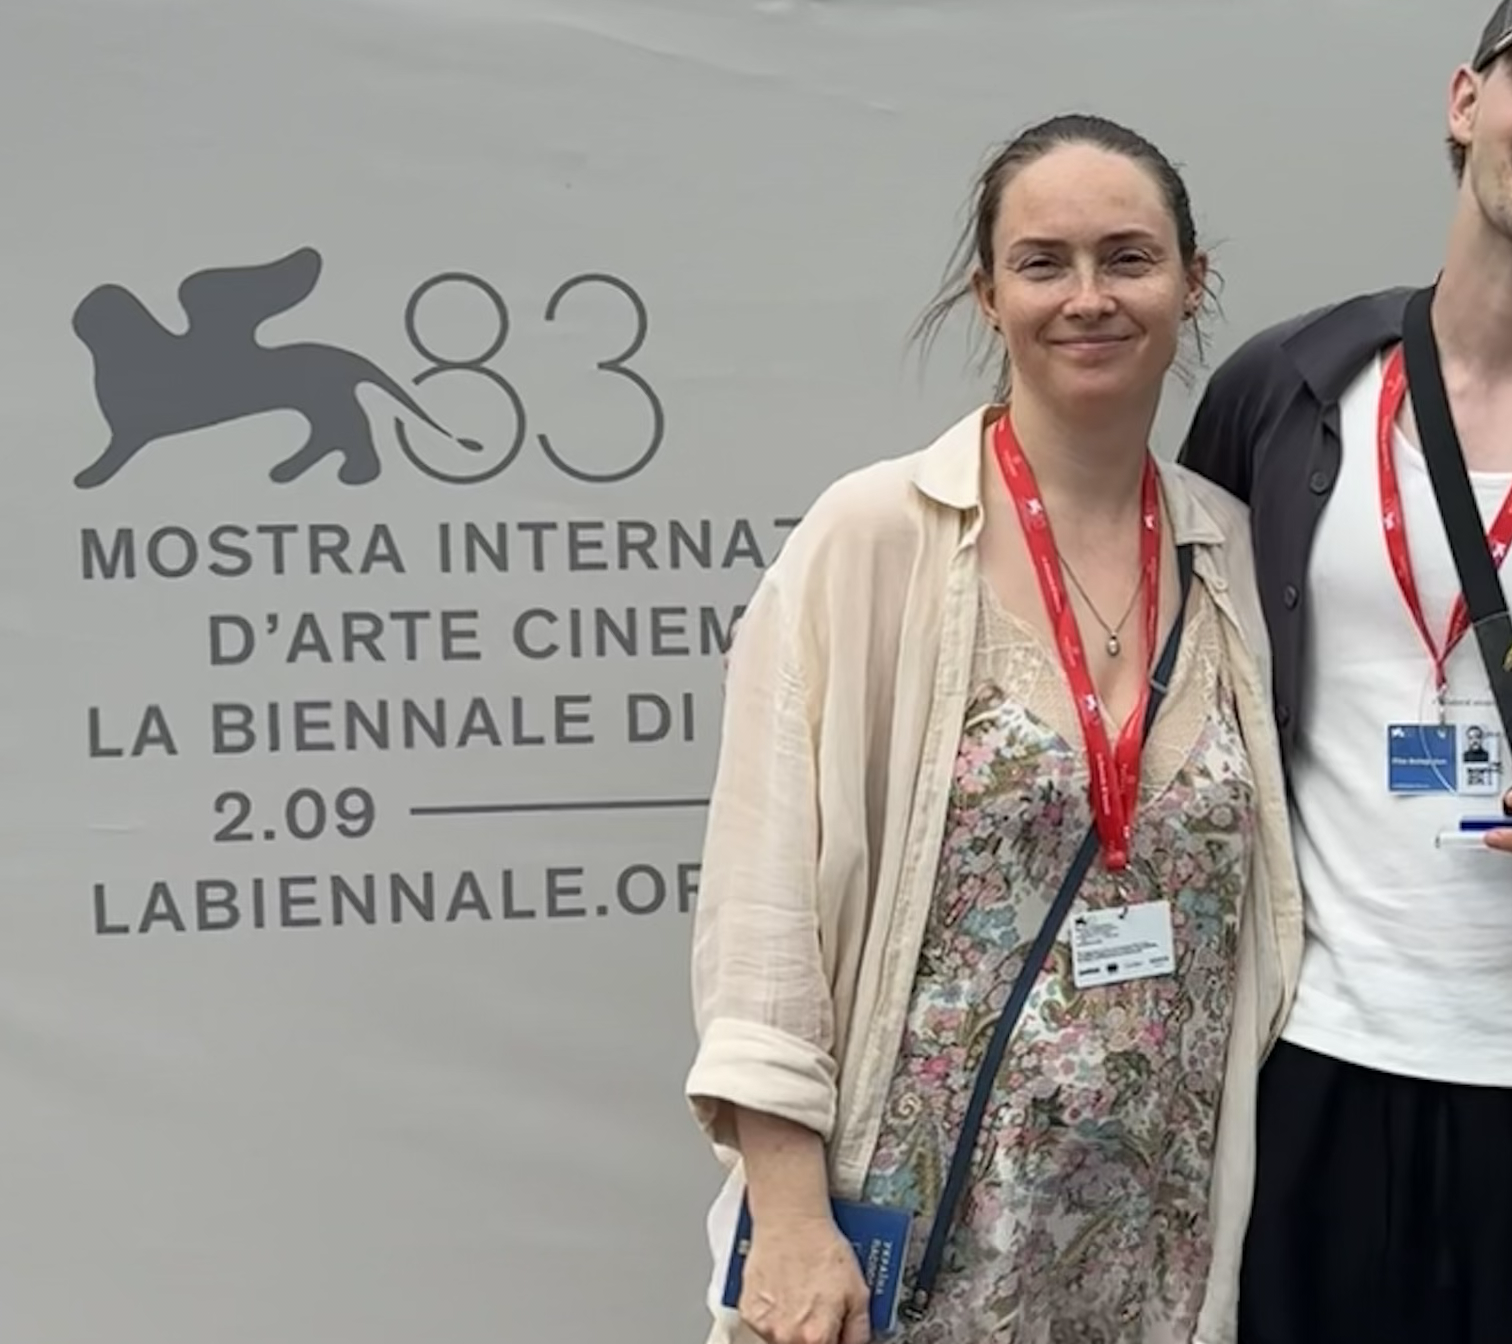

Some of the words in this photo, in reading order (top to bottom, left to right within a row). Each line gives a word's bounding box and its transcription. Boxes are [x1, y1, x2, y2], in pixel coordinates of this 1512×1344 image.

[395, 272, 665, 484] 83
[81, 523, 405, 579] MOSTRA
[209, 609, 481, 666] D’ARTE
[88, 706, 178, 758] LA
[212, 694, 595, 754] BIENNALE
[627, 692, 694, 743] DI
[214, 787, 376, 842] 2.09
